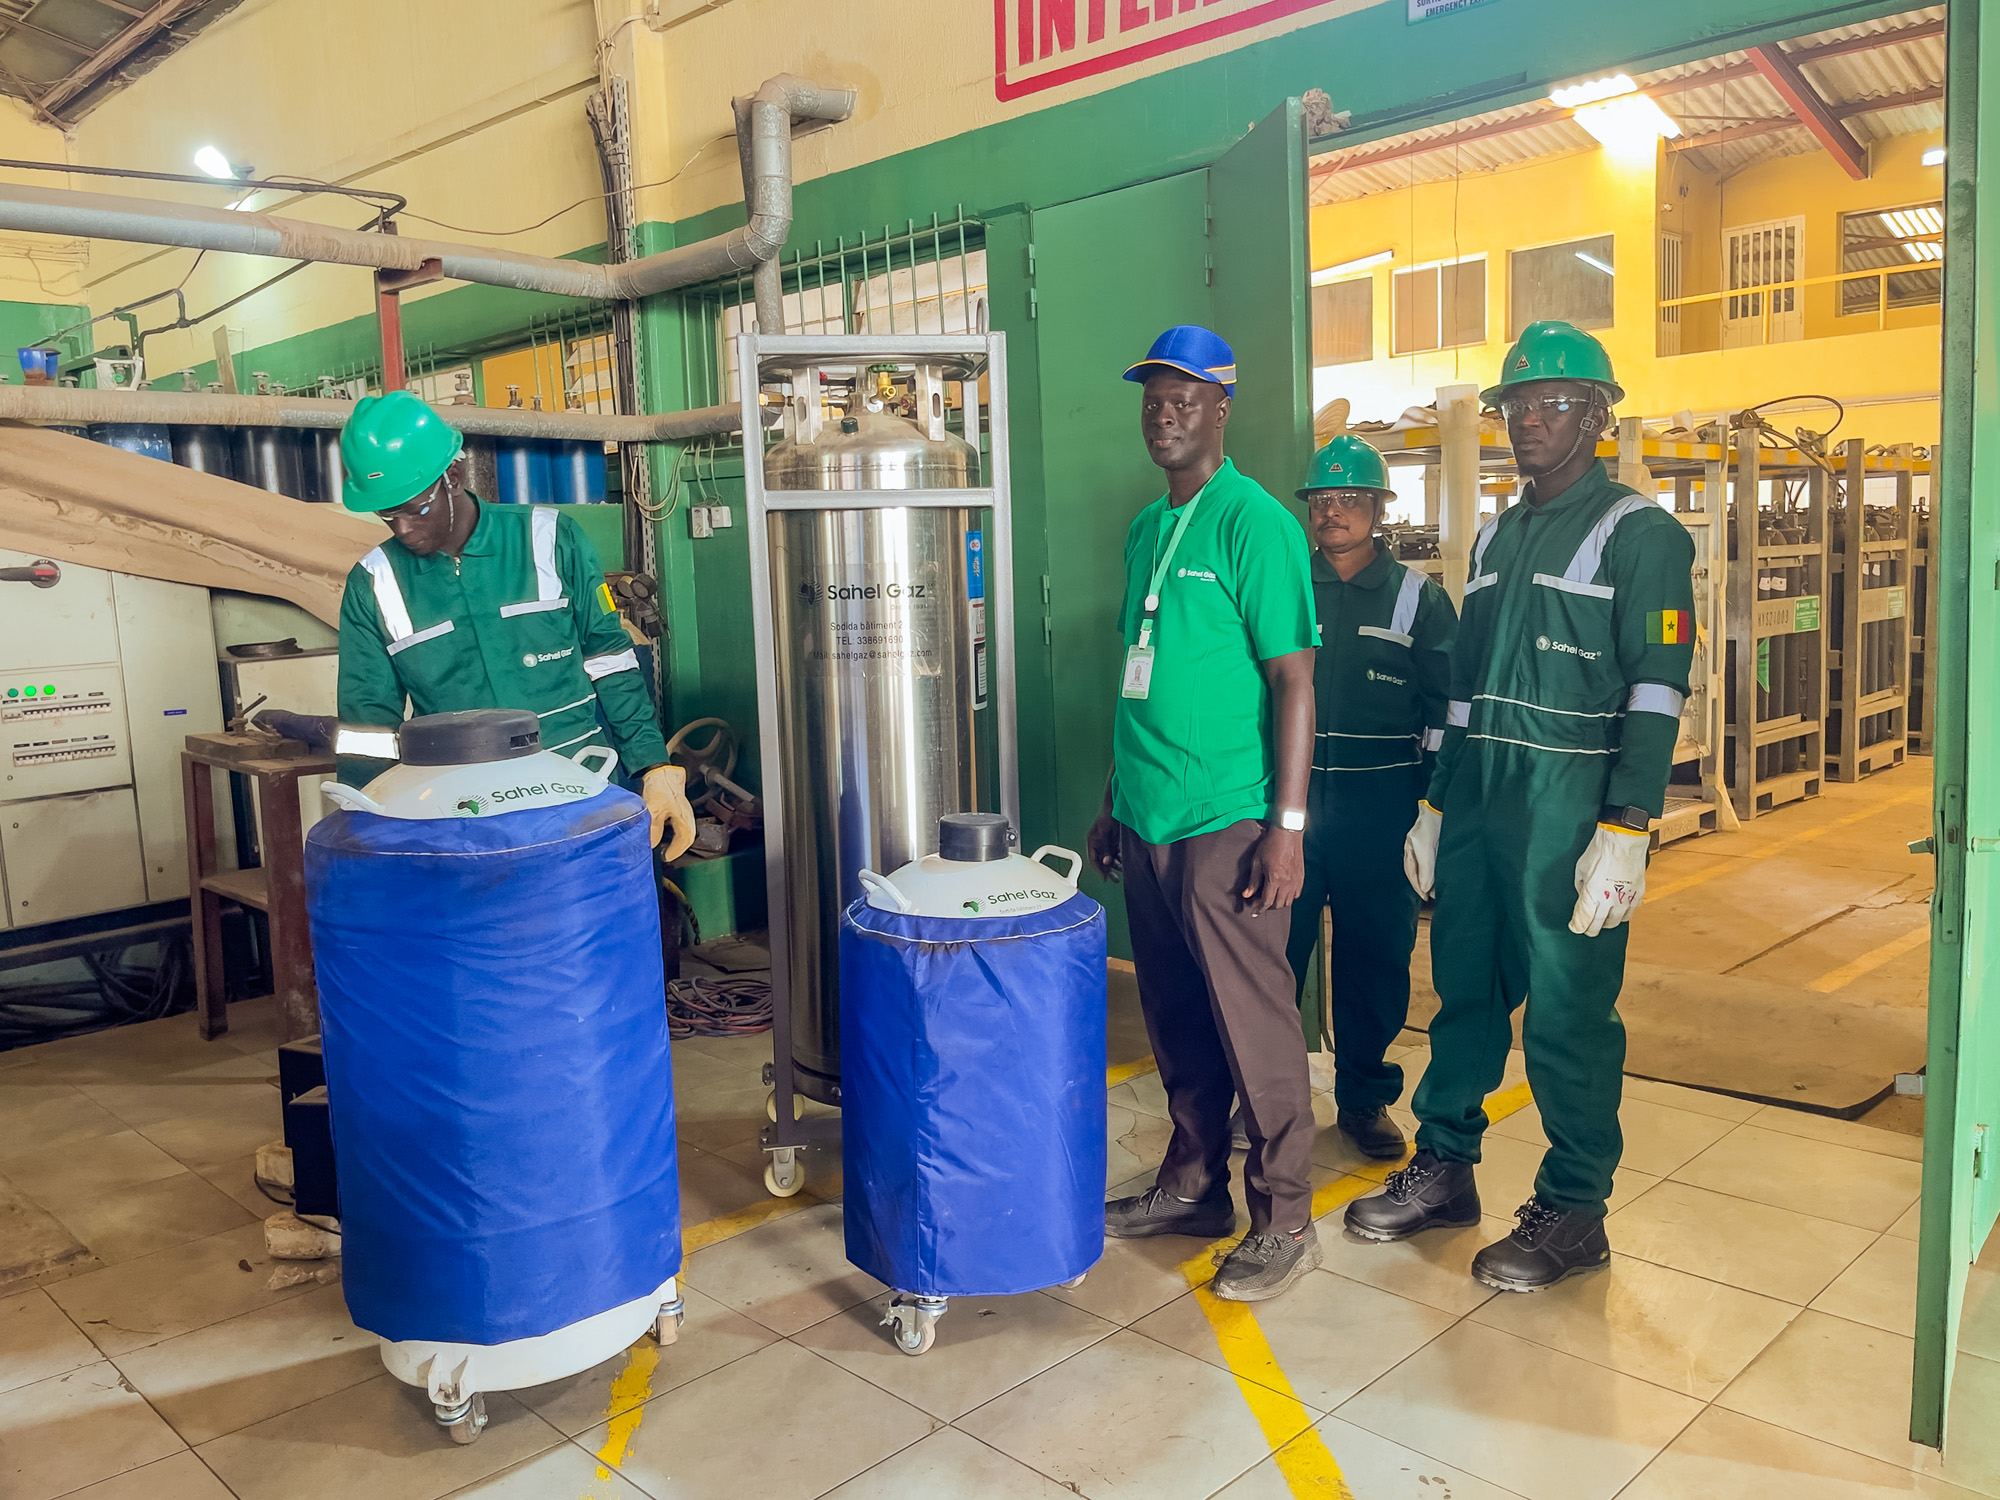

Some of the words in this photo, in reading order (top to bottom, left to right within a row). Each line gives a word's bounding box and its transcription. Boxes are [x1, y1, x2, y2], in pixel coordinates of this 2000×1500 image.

[1425, 0, 1468, 18] EMERGENCY
[827, 583, 881, 600] Sahel
[886, 583, 926, 598] Gaz
[830, 621, 858, 631] Sodida
[860, 620, 897, 631] bâtiment
[857, 636, 904, 644] 338691690
[1551, 641, 1578, 655] Sahel
[538, 651, 560, 662] Sahel
[491, 783, 549, 803] Sahel
[550, 782, 589, 795] Gaz
[988, 890, 1028, 904] Sahel
[1030, 889, 1058, 900] Gaz
